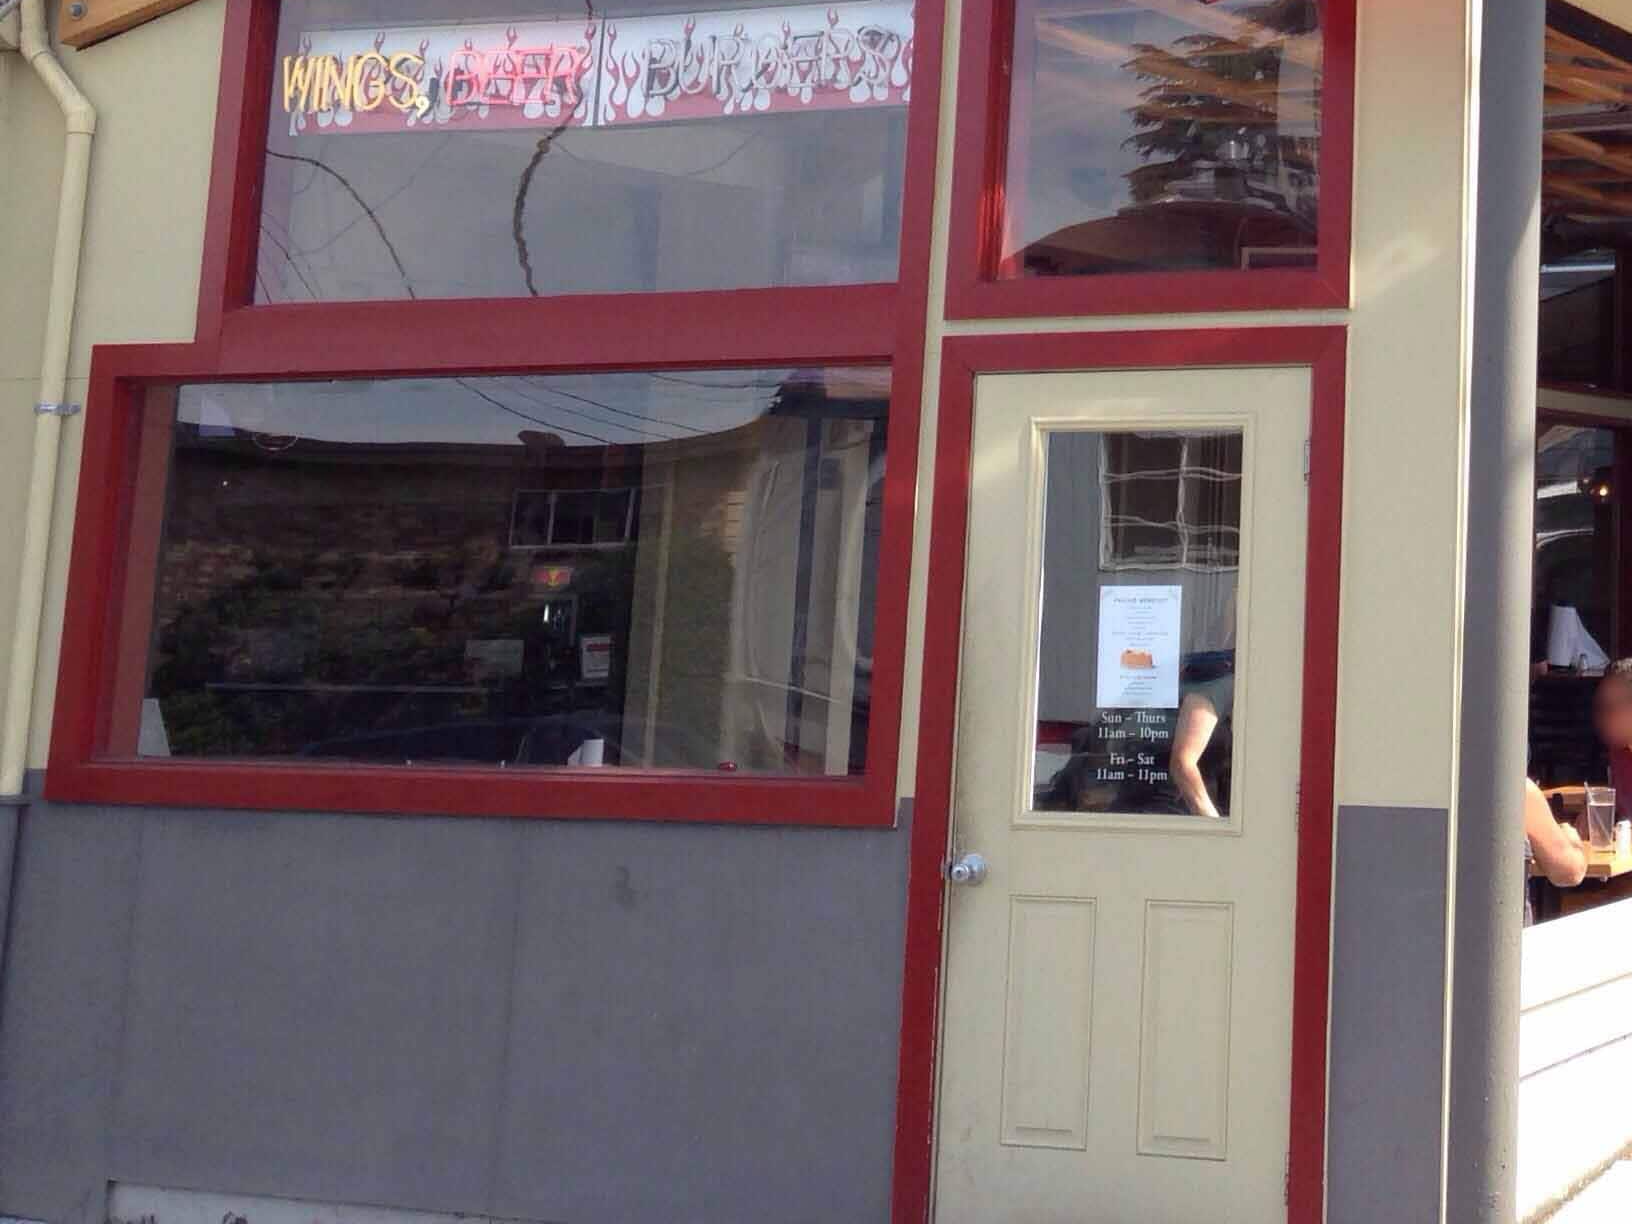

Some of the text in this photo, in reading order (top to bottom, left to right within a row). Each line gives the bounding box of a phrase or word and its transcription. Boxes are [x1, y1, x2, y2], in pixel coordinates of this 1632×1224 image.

[281, 24, 901, 118] WINGS, BEER BURGERS
[1101, 711, 1122, 724] Sun
[1134, 711, 1166, 724] Thurs
[1097, 727, 1126, 739] 11am
[1140, 727, 1169, 743] 10pm
[1109, 752, 1125, 765] Fri
[1136, 752, 1155, 765] Sat
[1096, 768, 1125, 780] 11am
[1137, 769, 1168, 785] 11pm
